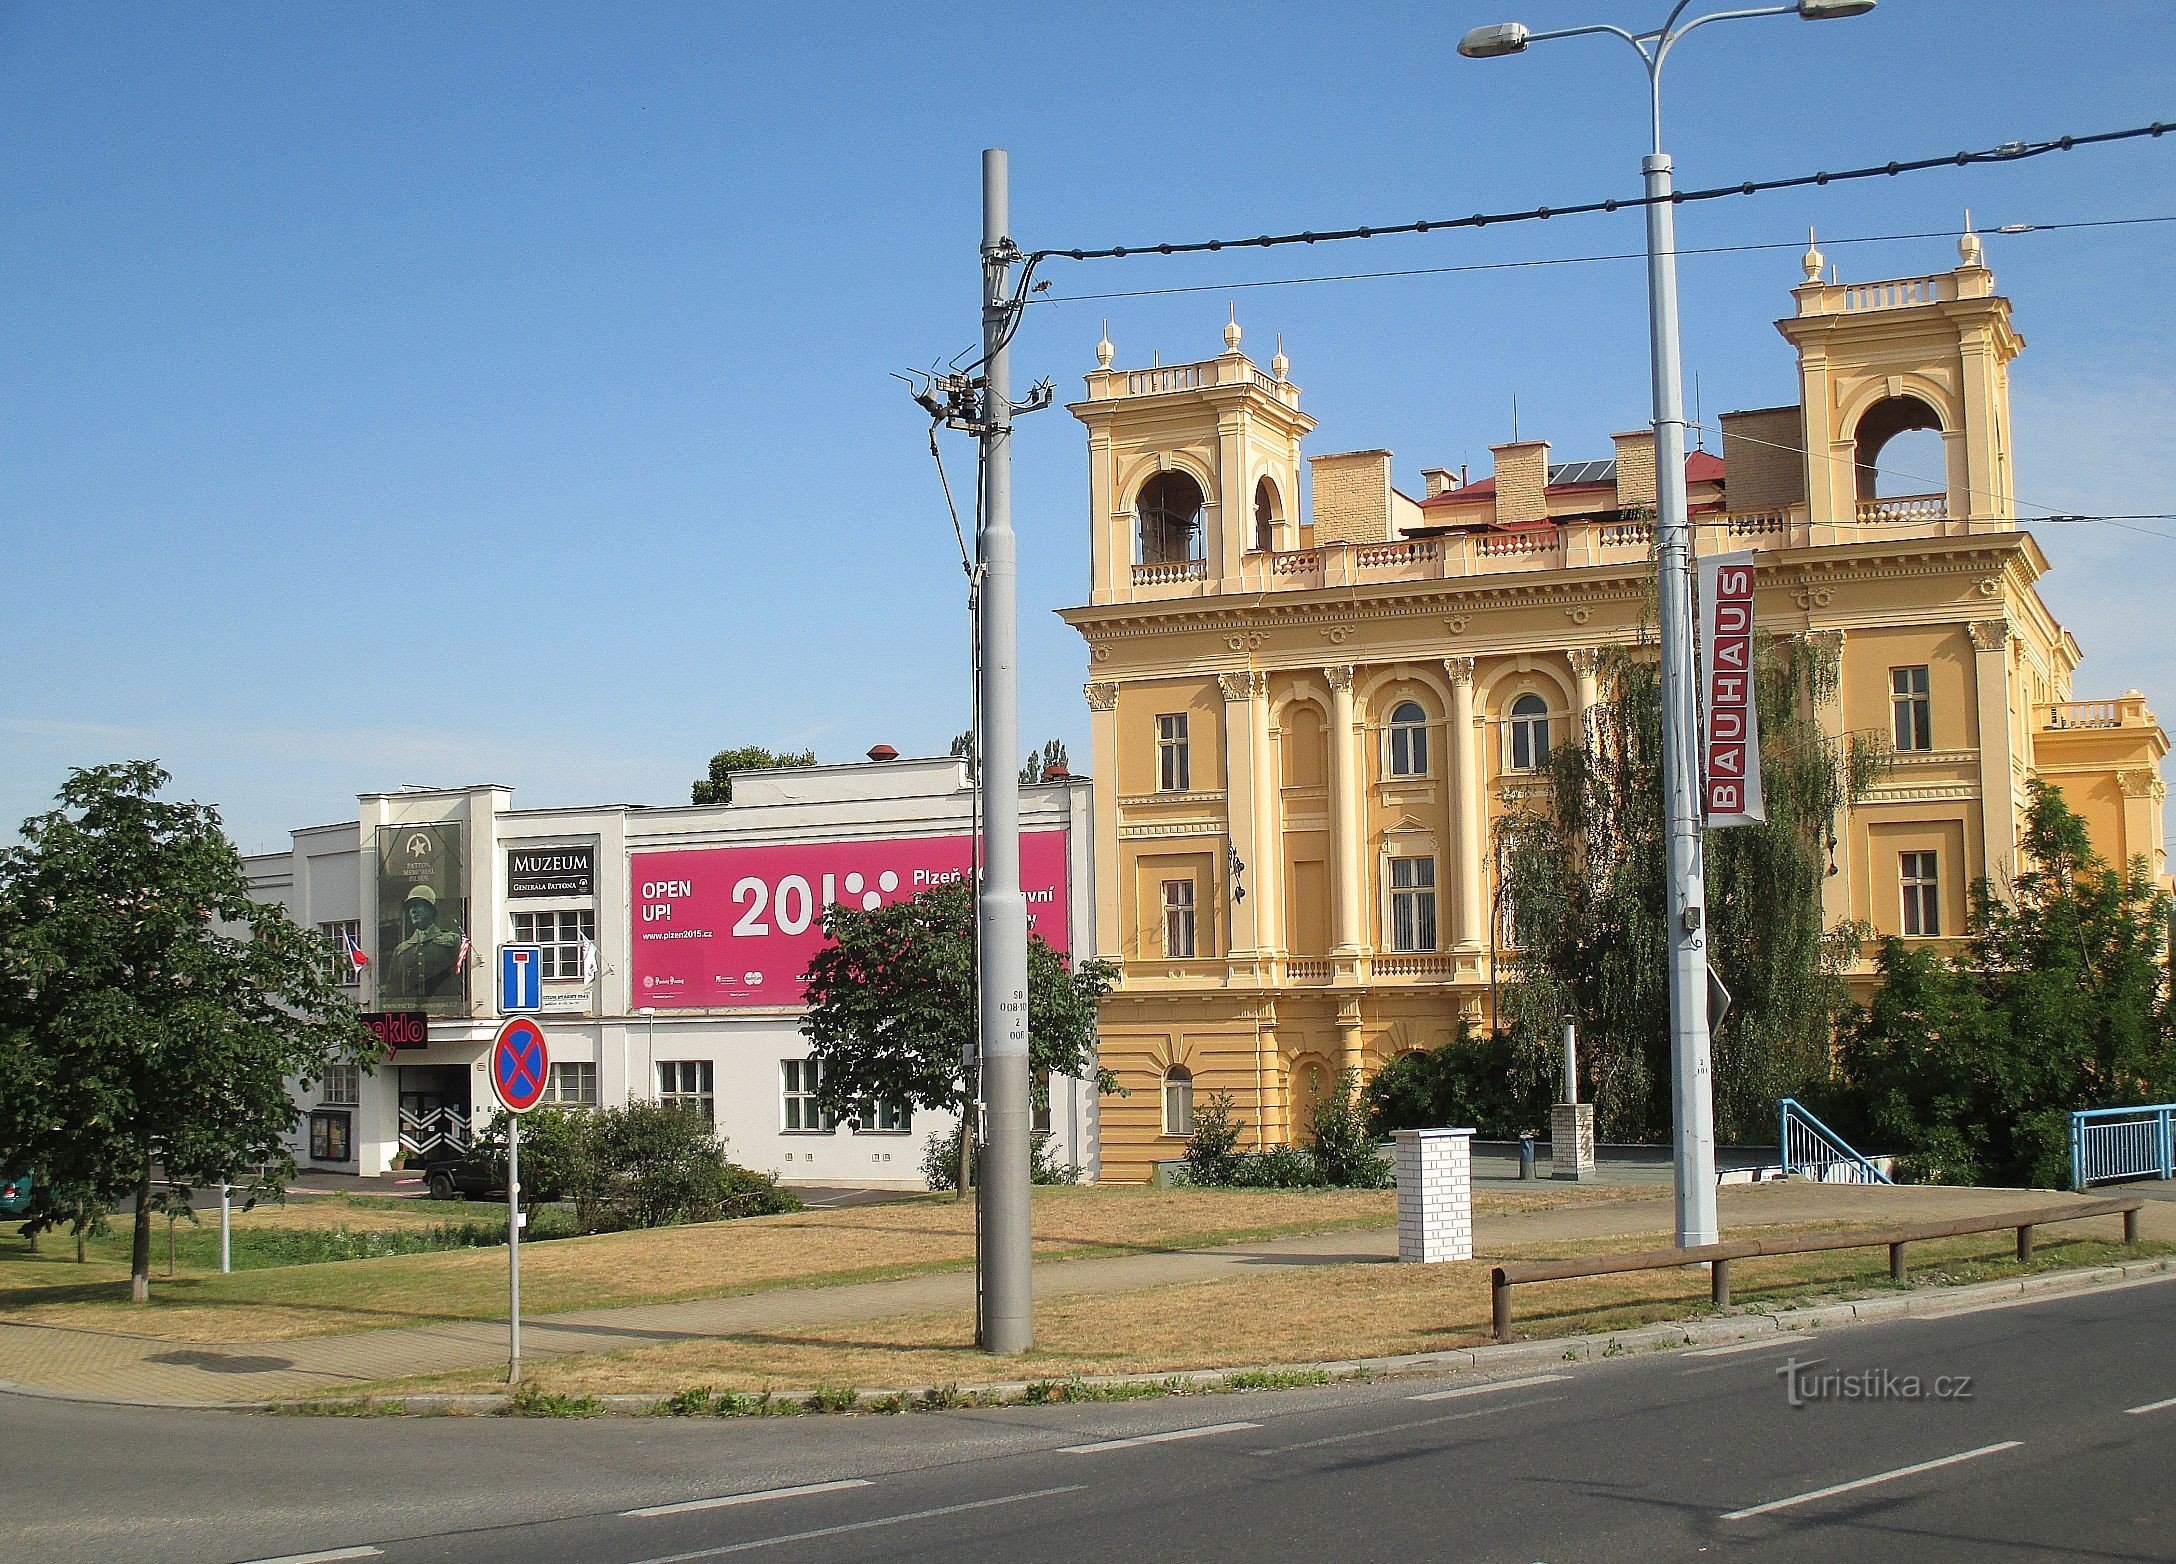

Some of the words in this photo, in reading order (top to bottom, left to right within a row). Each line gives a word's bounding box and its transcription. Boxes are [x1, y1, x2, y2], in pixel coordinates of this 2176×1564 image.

[1711, 569, 1749, 809] BAUHAUS
[514, 855, 589, 872] MUZEUM
[642, 880, 691, 899] OPEN
[642, 903, 671, 922] UP!
[642, 929, 713, 941] www.plzen2015.cz
[1015, 1018, 1021, 1027] 2
[1699, 1058, 1704, 1066] 2
